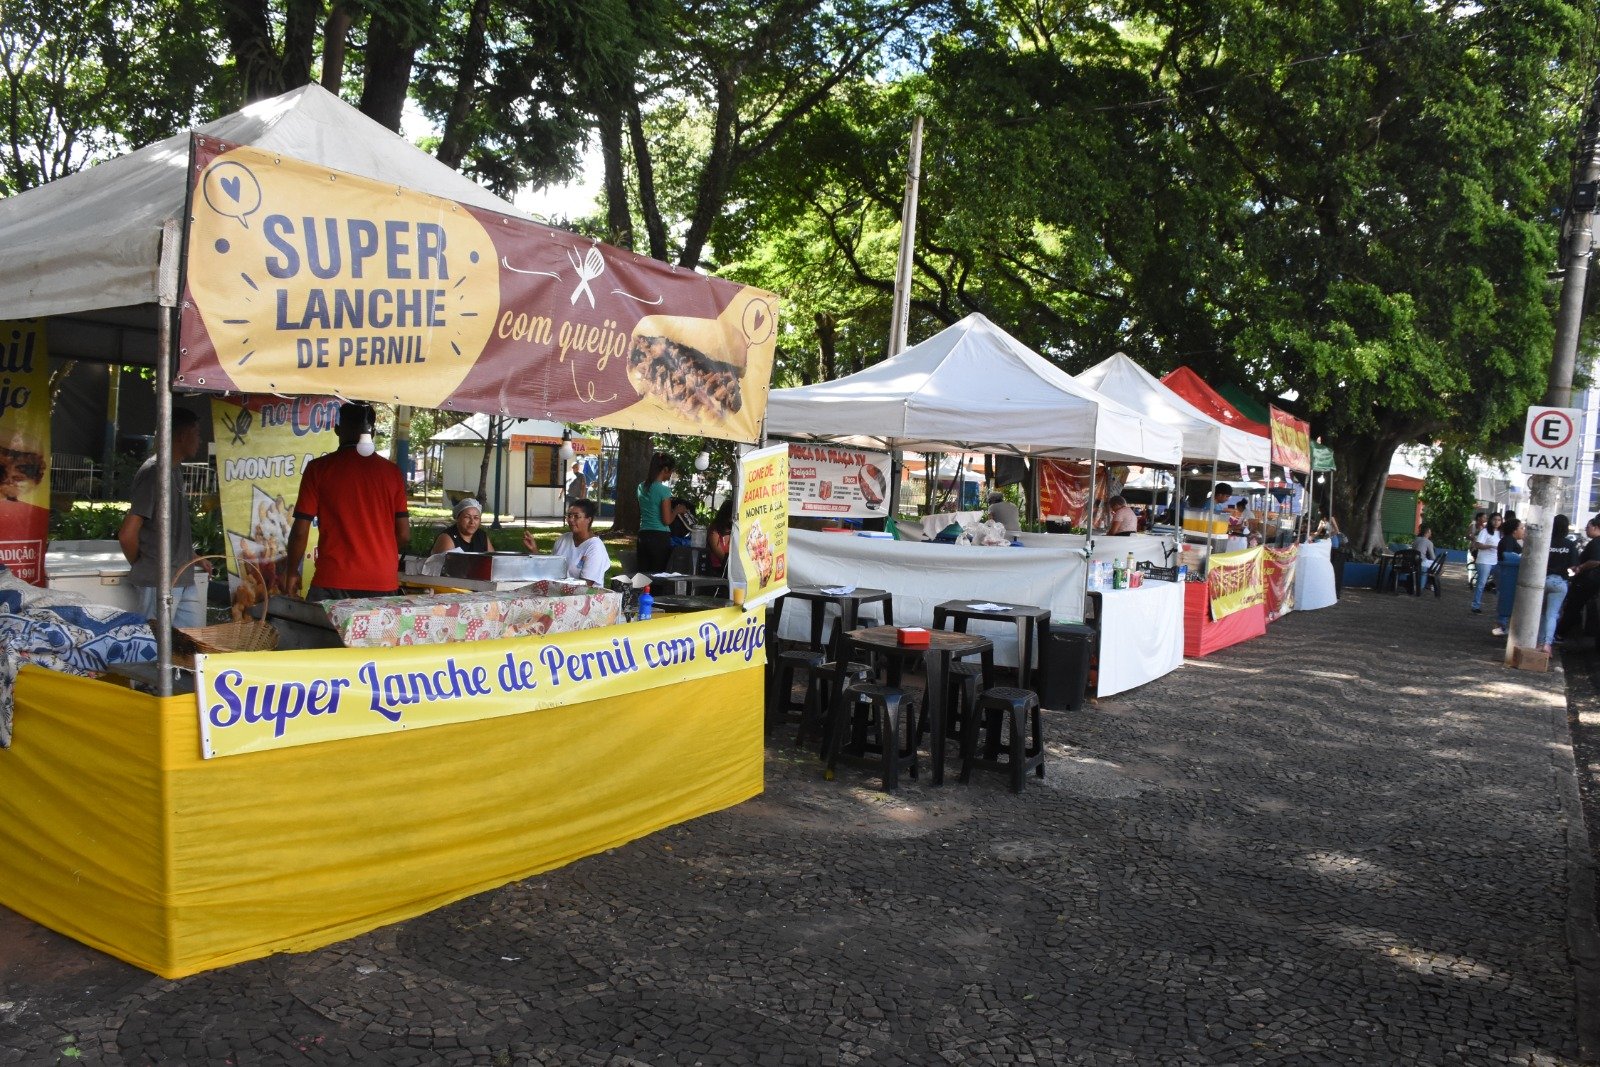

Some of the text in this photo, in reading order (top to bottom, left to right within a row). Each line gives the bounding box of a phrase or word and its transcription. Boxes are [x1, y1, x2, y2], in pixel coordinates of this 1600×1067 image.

[263, 214, 449, 280] SUPER
[276, 288, 446, 330] LANCHE
[297, 335, 426, 368] DE PERNIL
[499, 311, 627, 371] com queijo
[261, 402, 289, 428] no
[1542, 419, 1561, 441] E
[225, 454, 295, 481] MONTE
[748, 464, 774, 483] CONE DE
[1526, 454, 1569, 471] TAXI
[744, 486, 769, 503] BATATA
[745, 504, 768, 519] MONTE
[209, 616, 766, 738] Super Lanche de Pernil com Queijo
